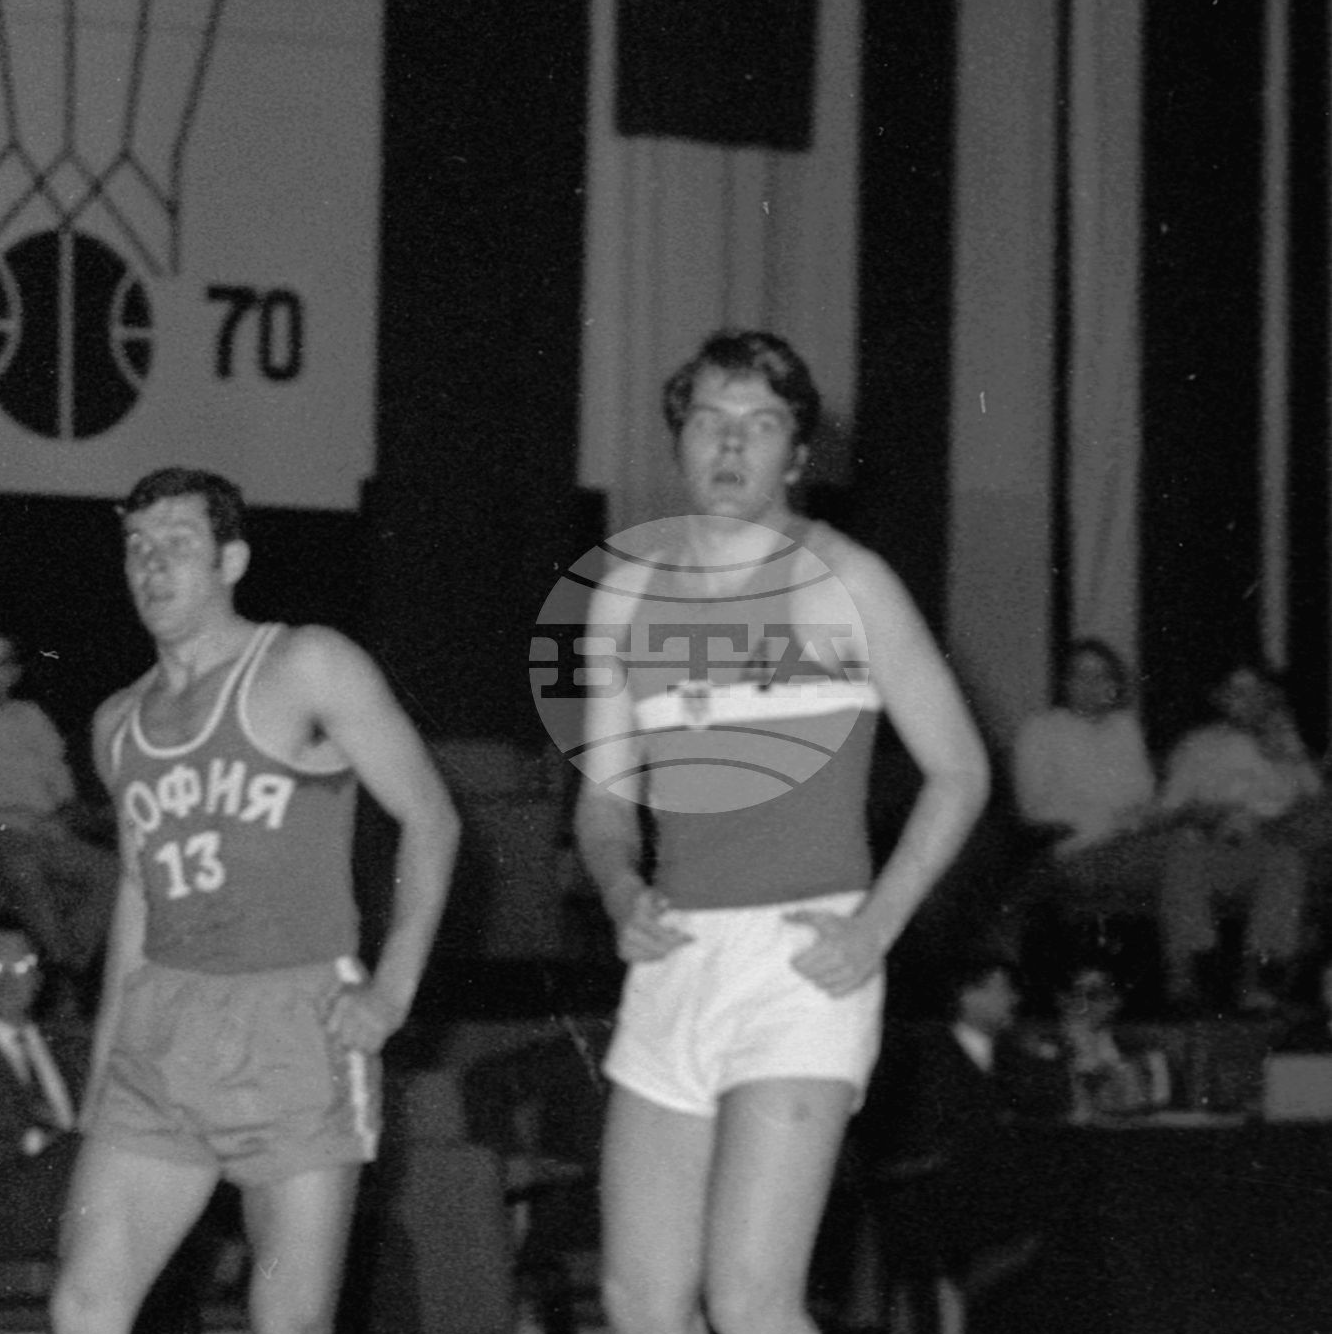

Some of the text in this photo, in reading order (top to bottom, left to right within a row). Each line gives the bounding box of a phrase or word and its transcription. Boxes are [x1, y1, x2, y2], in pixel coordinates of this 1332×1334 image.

[207, 284, 303, 381] 70
[124, 758, 295, 829] ОФИЯ
[154, 830, 225, 899] 13
